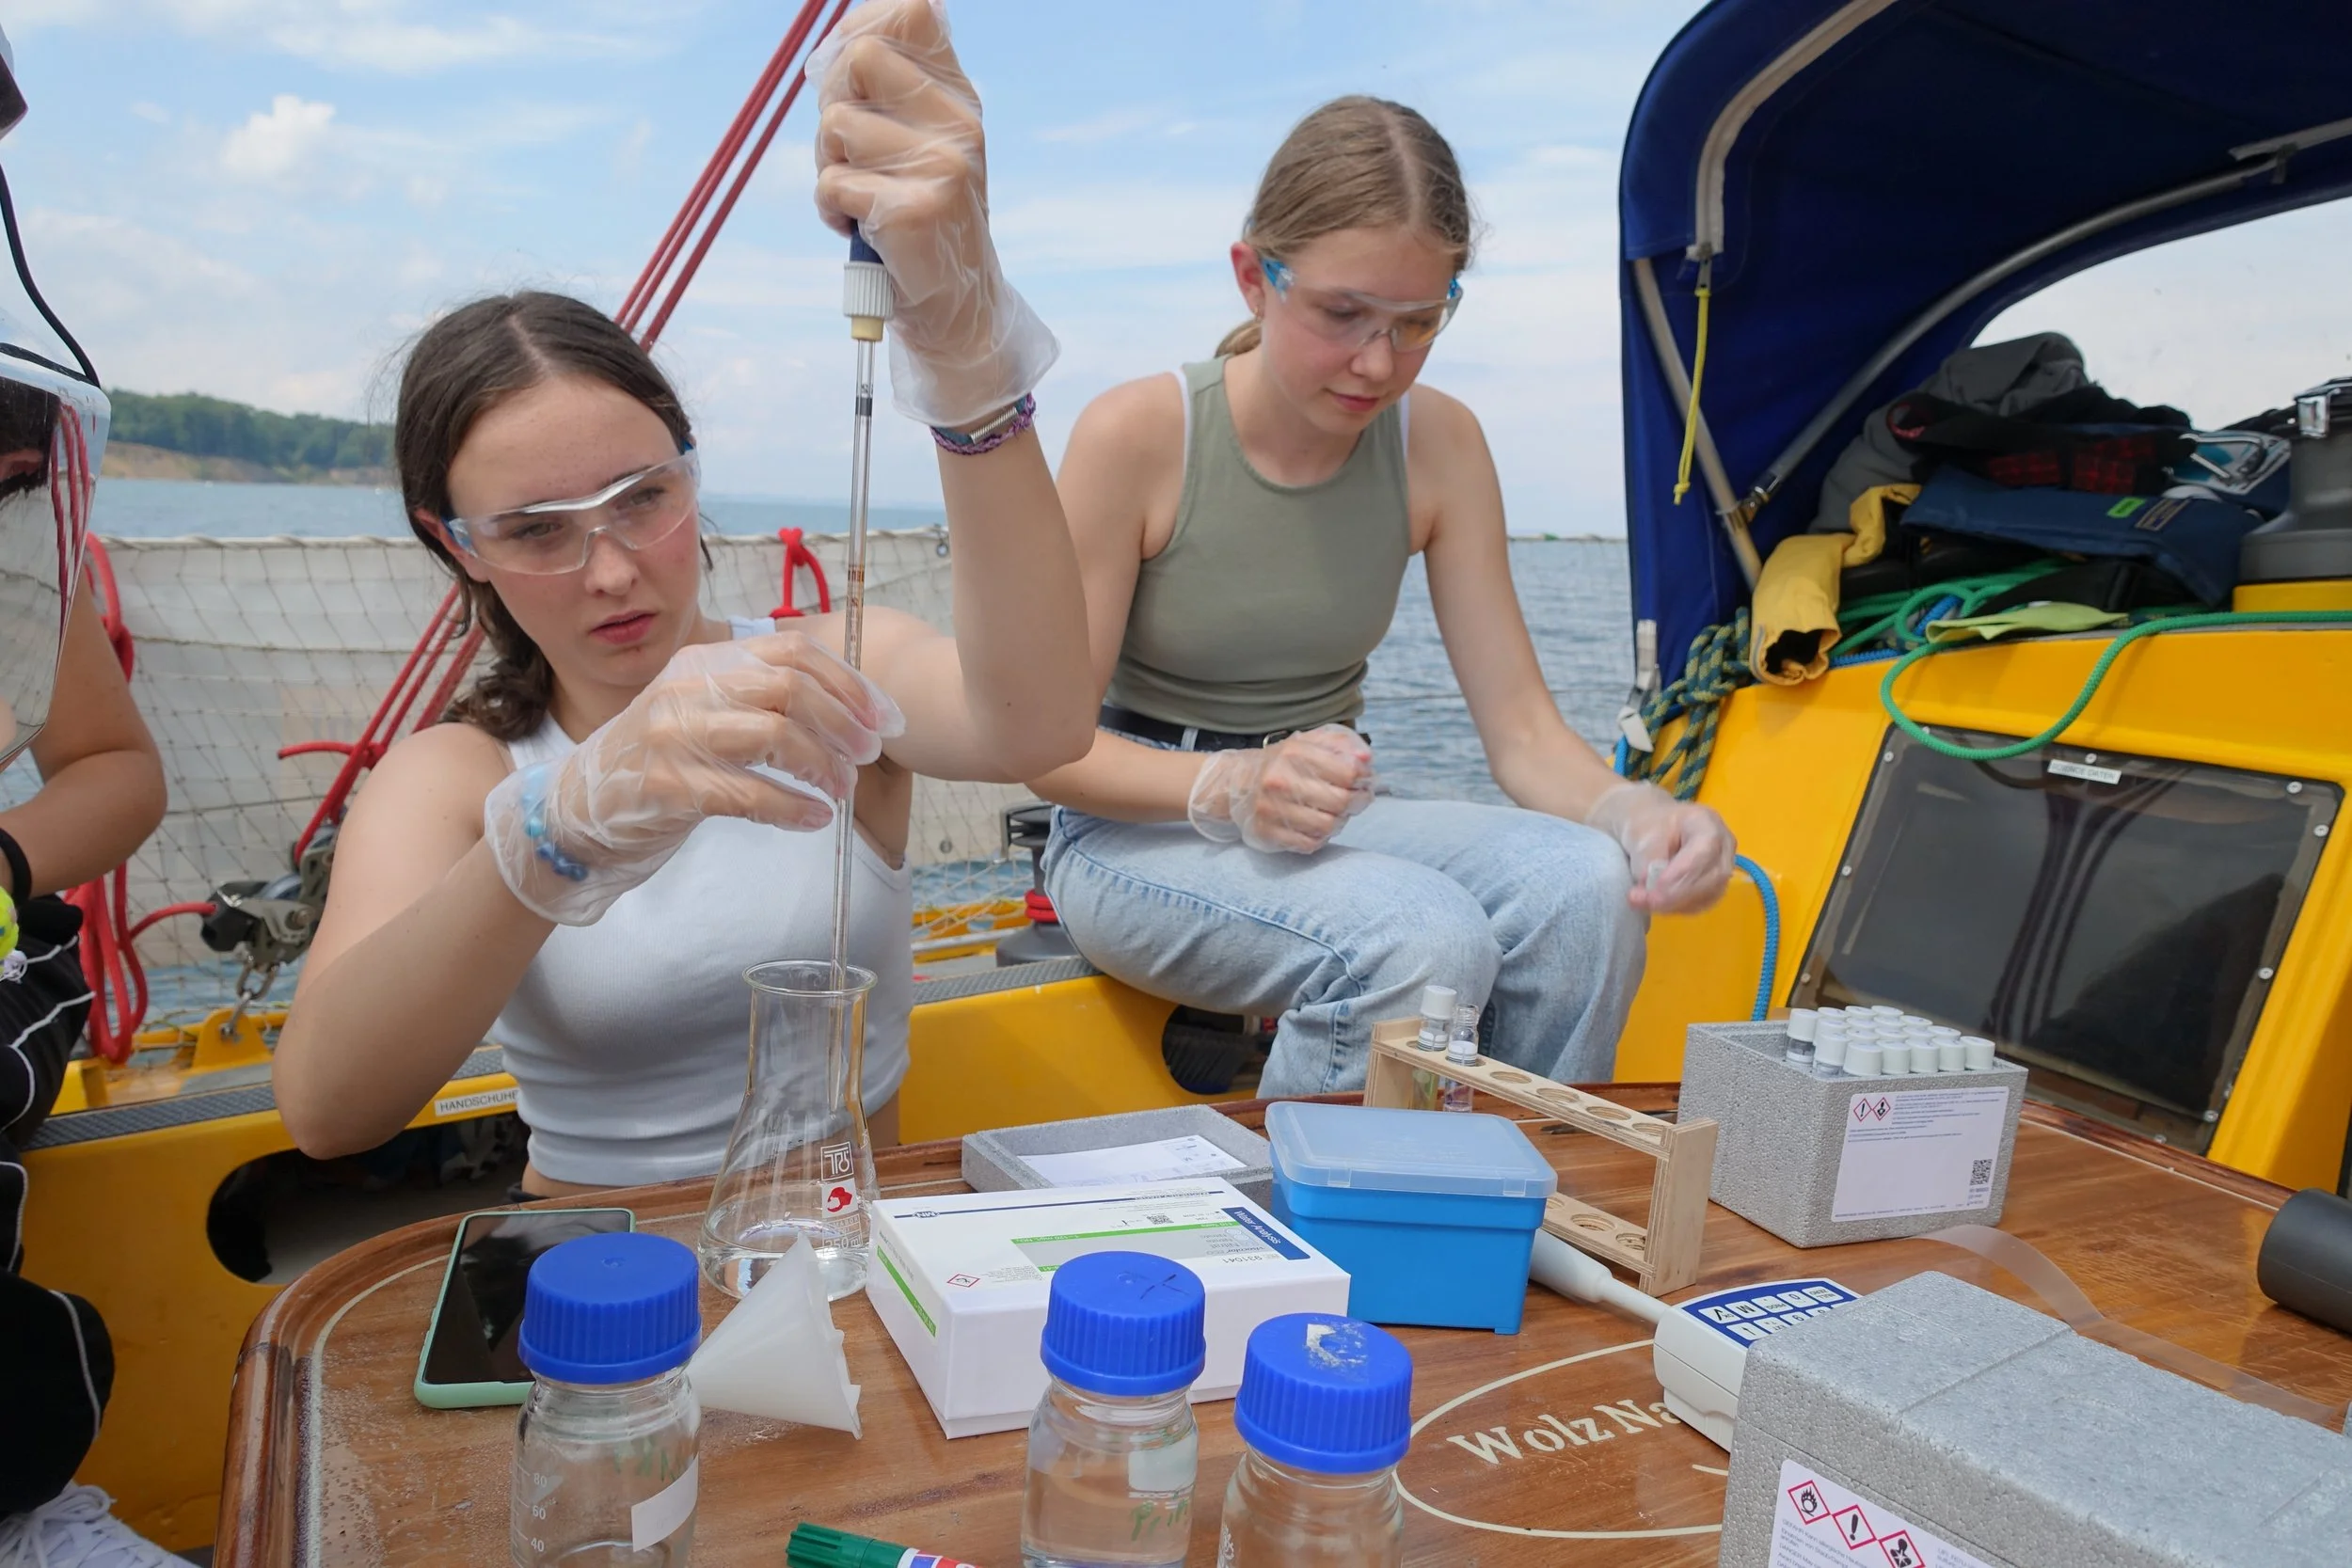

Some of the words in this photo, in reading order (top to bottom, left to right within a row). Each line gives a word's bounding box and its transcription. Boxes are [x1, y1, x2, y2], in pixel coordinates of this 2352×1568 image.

[1233, 1210, 1256, 1227] Water
[1251, 1224, 1281, 1244] Analysis
[1223, 1255, 1263, 1263] 931041
[1736, 1305, 1756, 1314] M
[533, 1472, 548, 1487] 80
[532, 1505, 546, 1520] 60
[531, 1537, 545, 1552] 40
